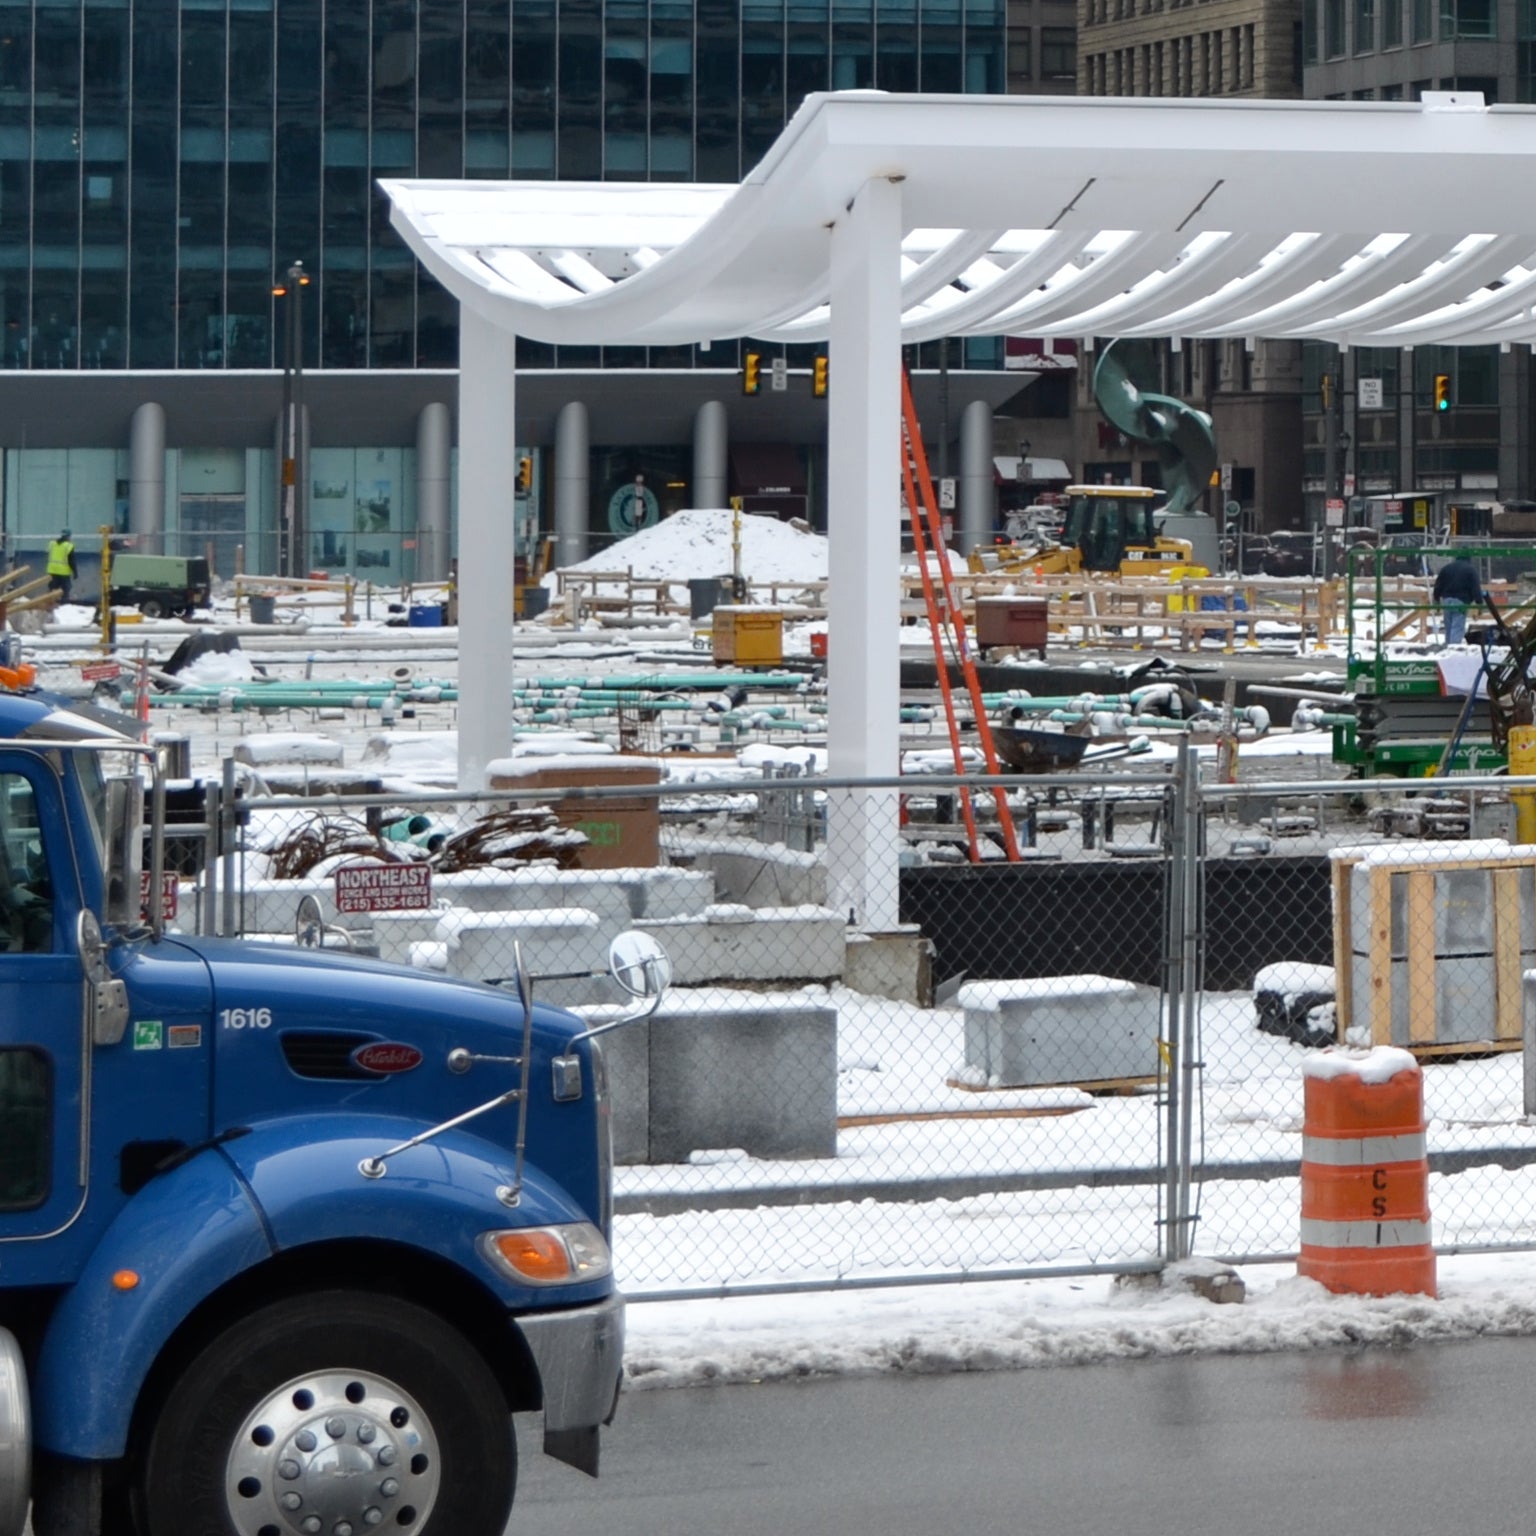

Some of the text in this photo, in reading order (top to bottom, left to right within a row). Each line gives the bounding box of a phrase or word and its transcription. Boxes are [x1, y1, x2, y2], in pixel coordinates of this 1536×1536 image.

[1128, 551, 1144, 560] CAT
[339, 869, 428, 888] NORTHEAST
[363, 888, 379, 896] AND
[339, 898, 371, 910] (215)
[221, 1008, 272, 1029] 1616
[363, 1047, 416, 1065] Peterbilt
